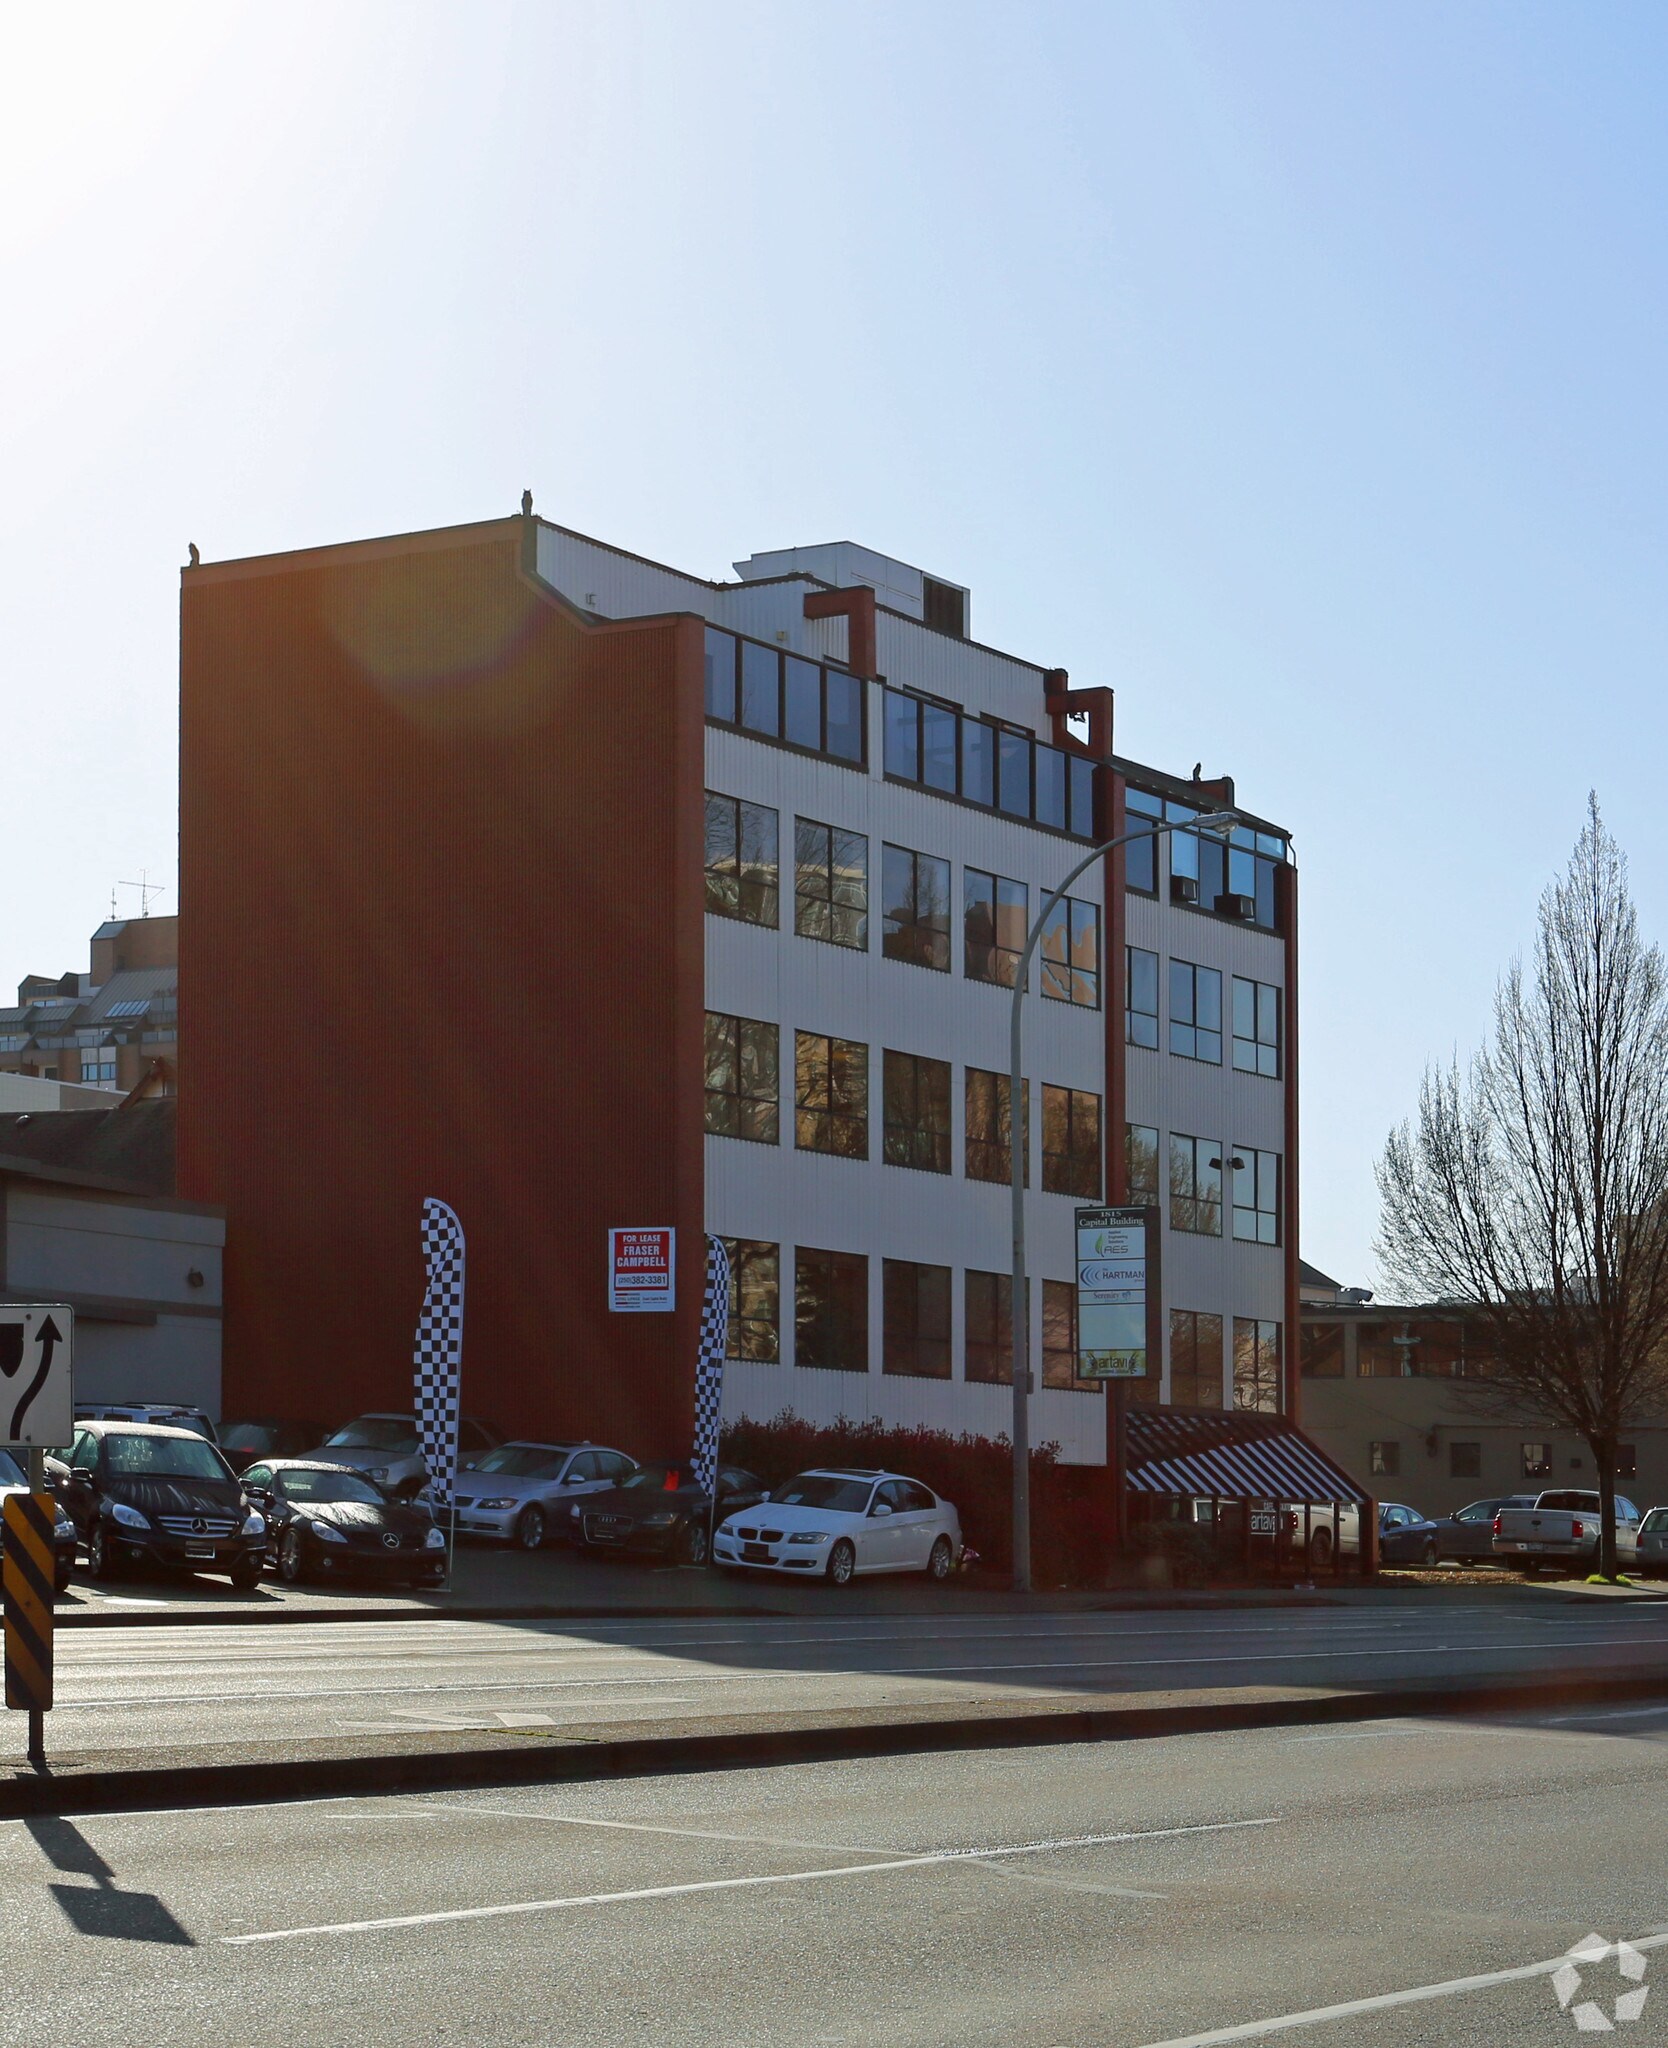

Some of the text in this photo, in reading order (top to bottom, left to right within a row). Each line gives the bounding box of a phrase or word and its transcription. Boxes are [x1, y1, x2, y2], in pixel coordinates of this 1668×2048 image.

[1079, 1216, 1144, 1228] Capital Building
[639, 1234, 661, 1242] LEASE
[623, 1245, 660, 1256] FRASER
[1104, 1245, 1128, 1254] AES
[616, 1256, 666, 1267] CAMPBELL
[1102, 1270, 1144, 1279] HARTMAN
